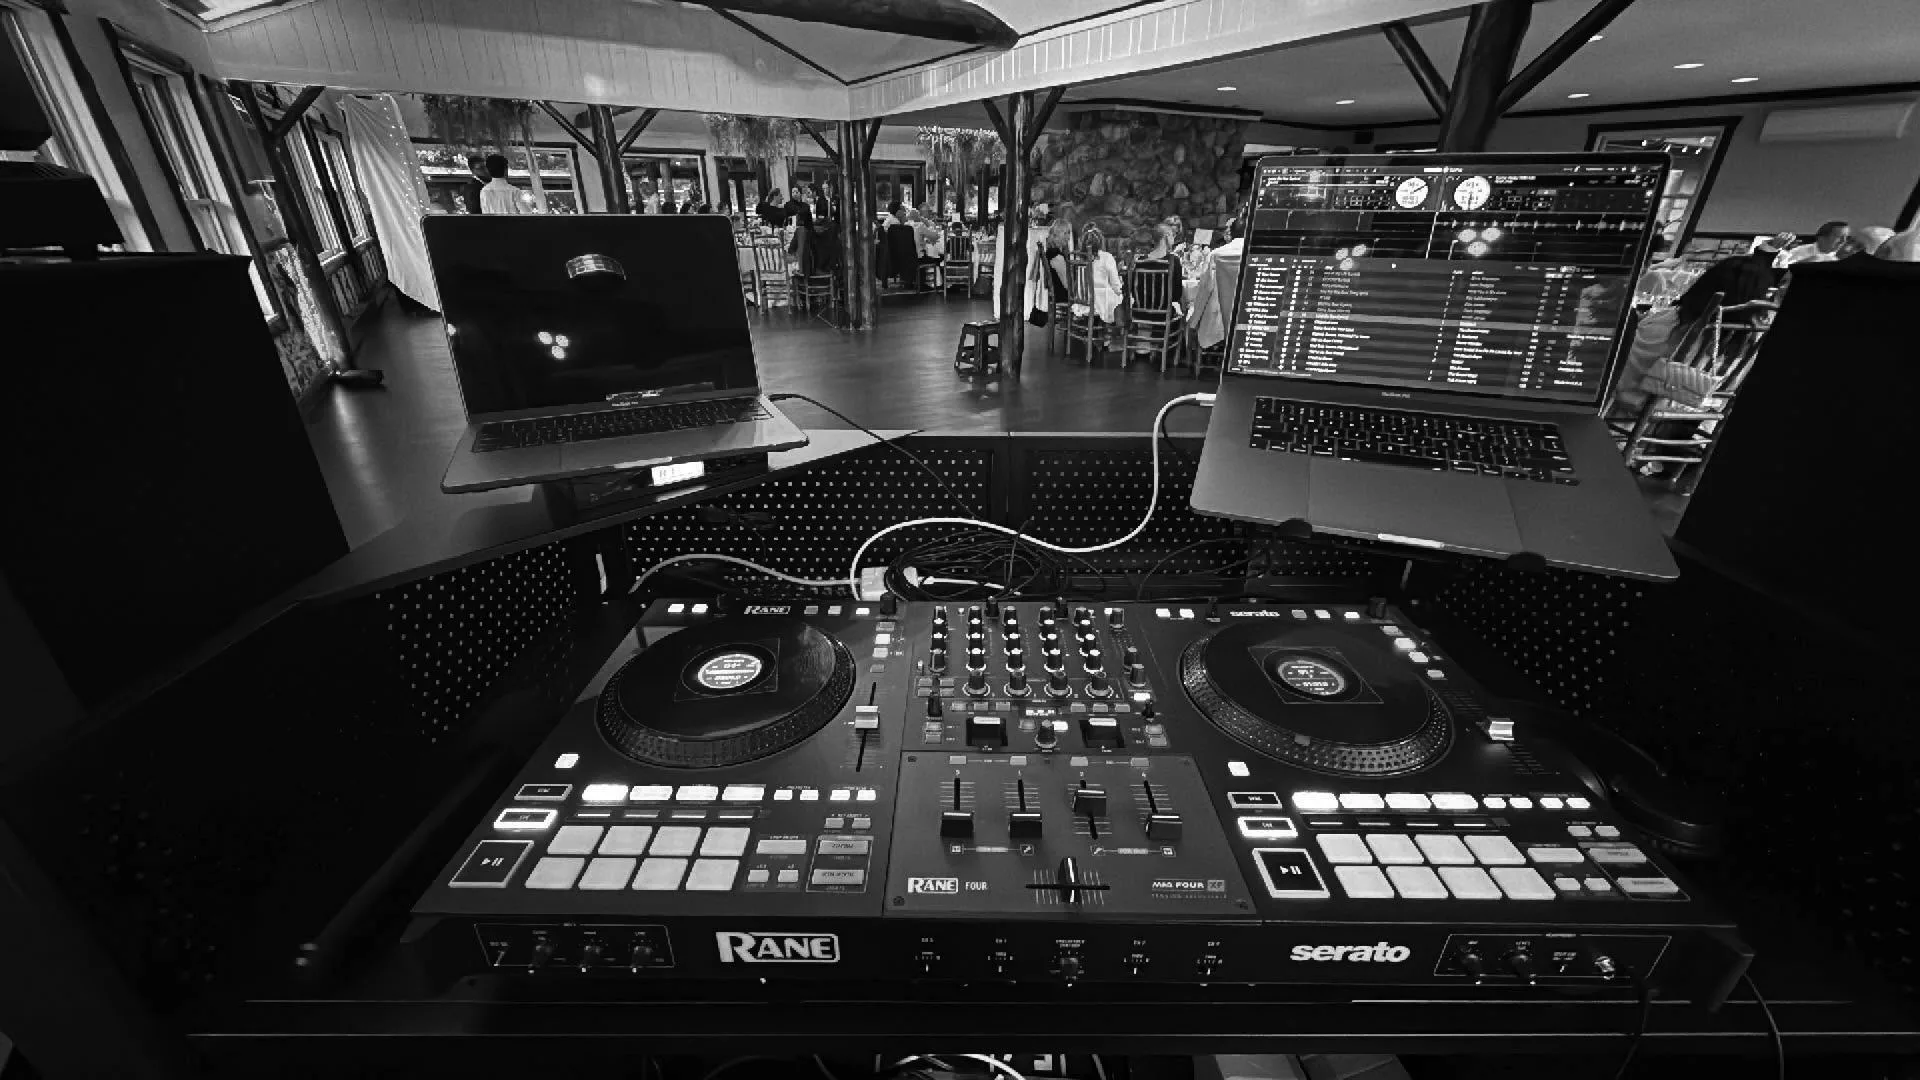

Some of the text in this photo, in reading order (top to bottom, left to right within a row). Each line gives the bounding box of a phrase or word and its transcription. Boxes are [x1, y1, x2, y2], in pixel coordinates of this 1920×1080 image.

[908, 878, 988, 893] RANE FOUR
[1175, 881, 1205, 889] FOUR
[716, 932, 840, 962] RANE
[1290, 941, 1411, 963] serato
